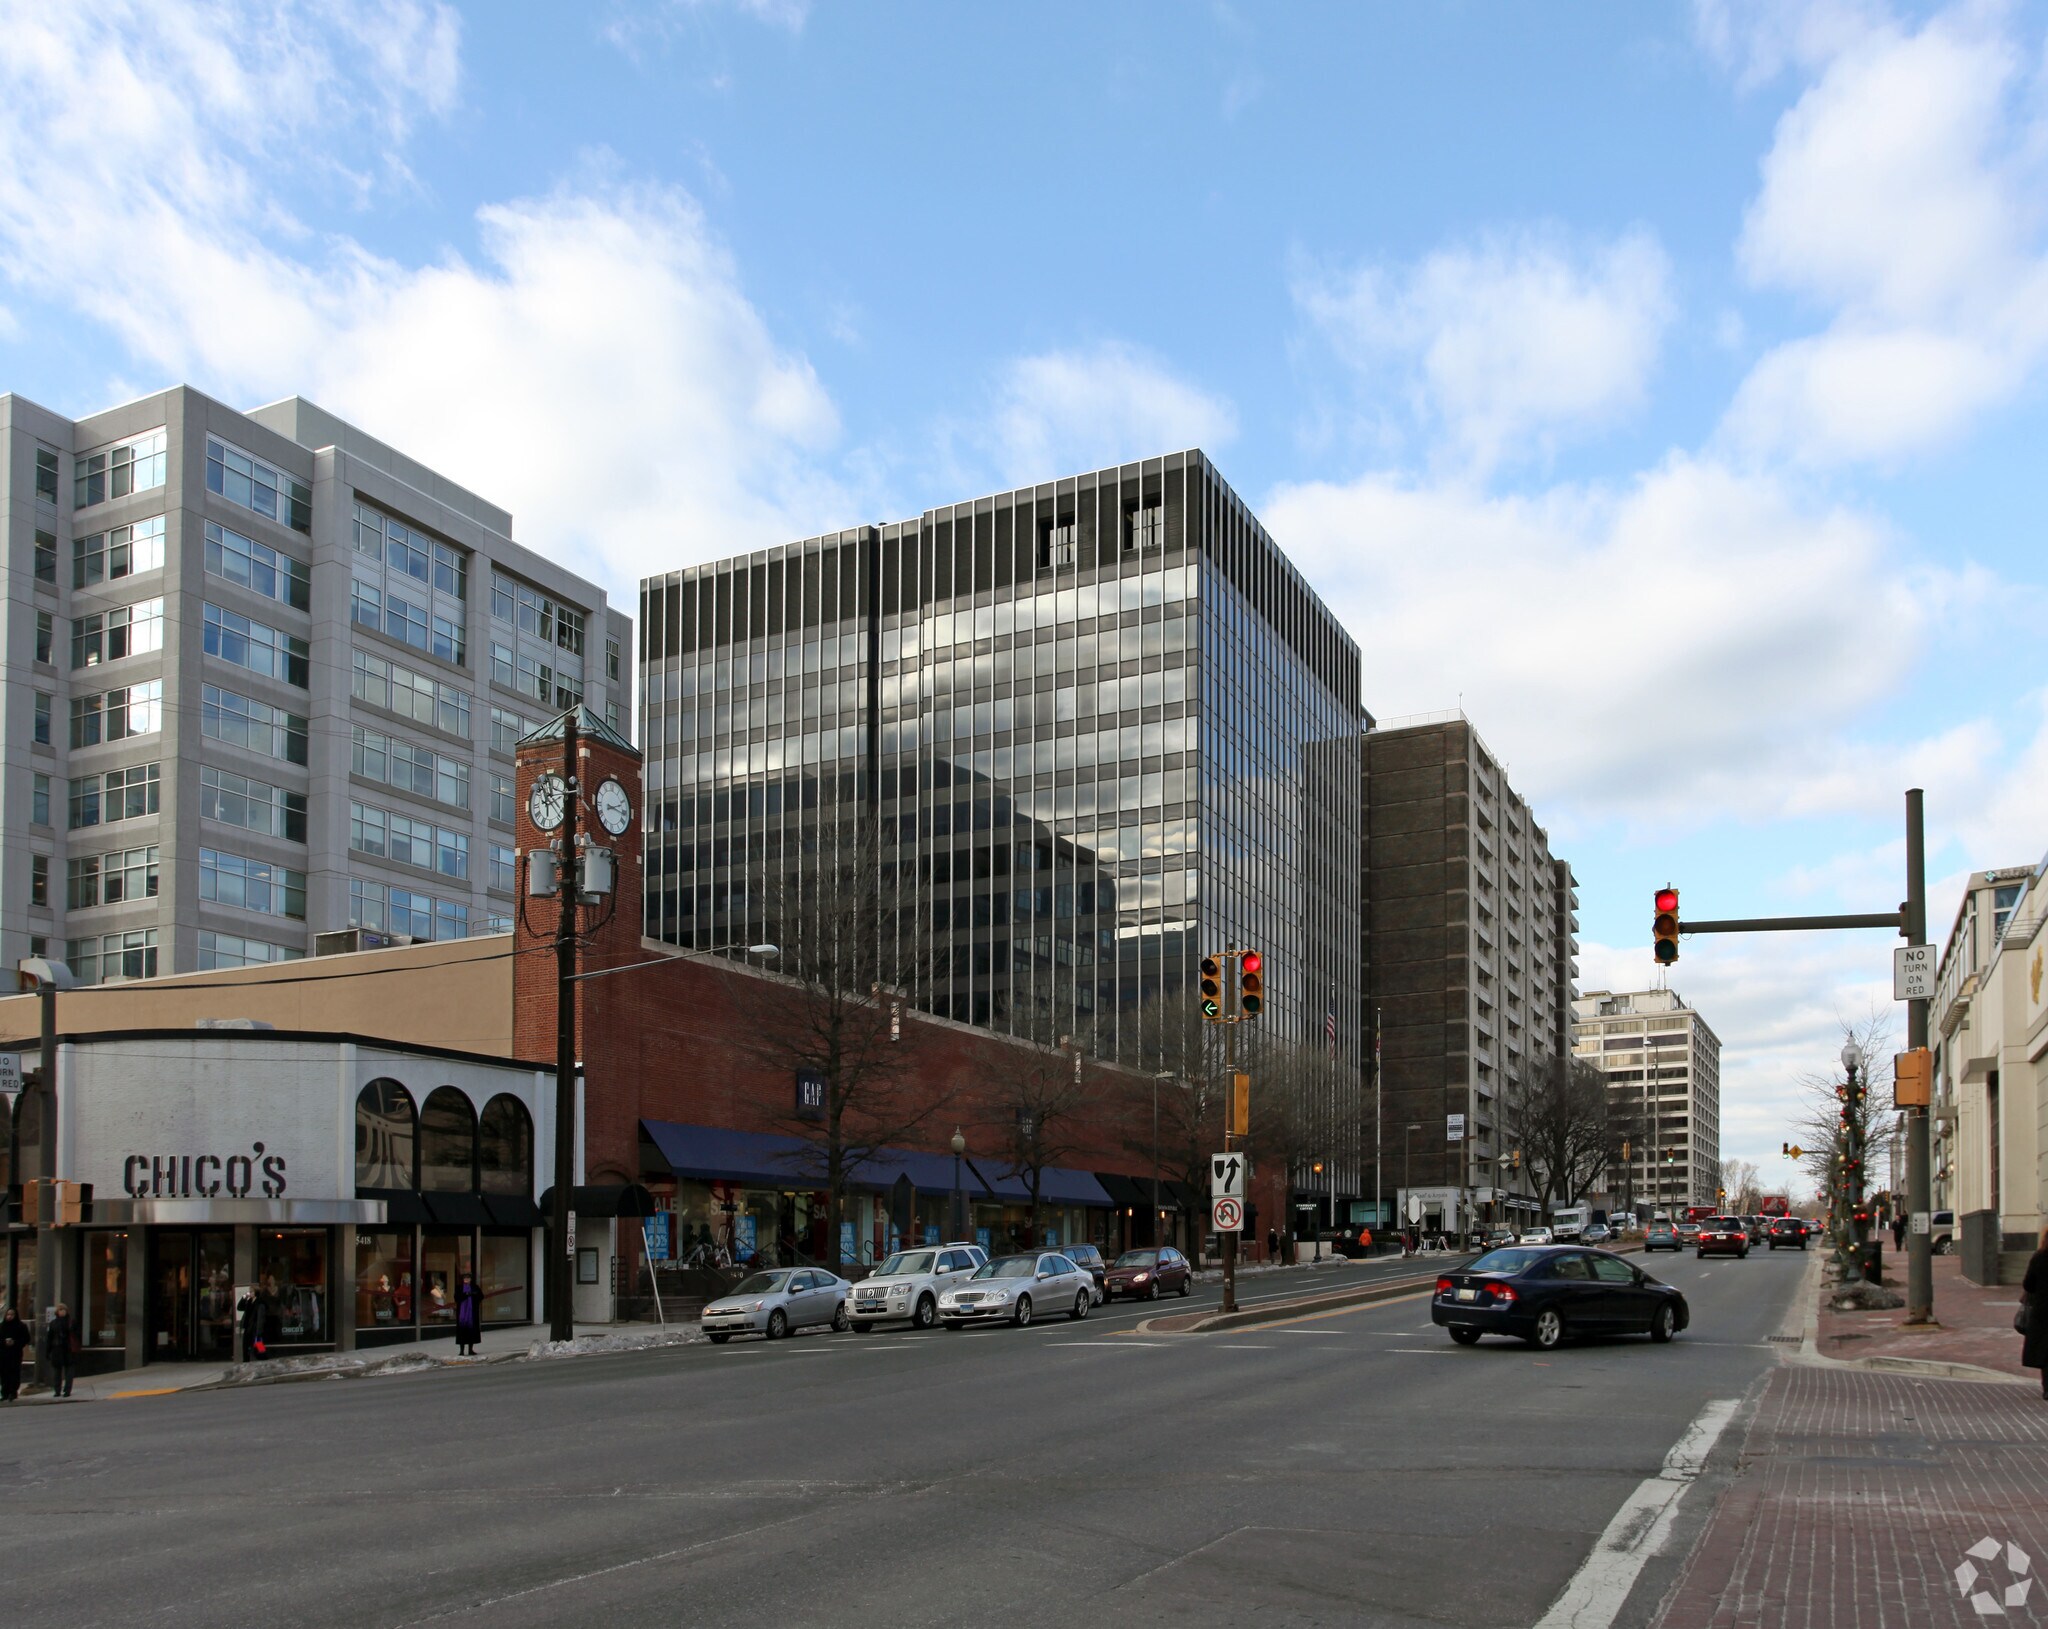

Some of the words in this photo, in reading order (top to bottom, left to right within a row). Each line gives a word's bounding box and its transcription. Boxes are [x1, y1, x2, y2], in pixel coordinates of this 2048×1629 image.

[1906, 950, 1925, 961] NO
[1903, 963, 1928, 973] TURN
[1908, 975, 1922, 984] ON
[1906, 985, 1925, 995] RED
[2, 1079, 19, 1089] RED
[804, 1081, 822, 1106] GAP
[124, 1141, 286, 1195] CHICO'S
